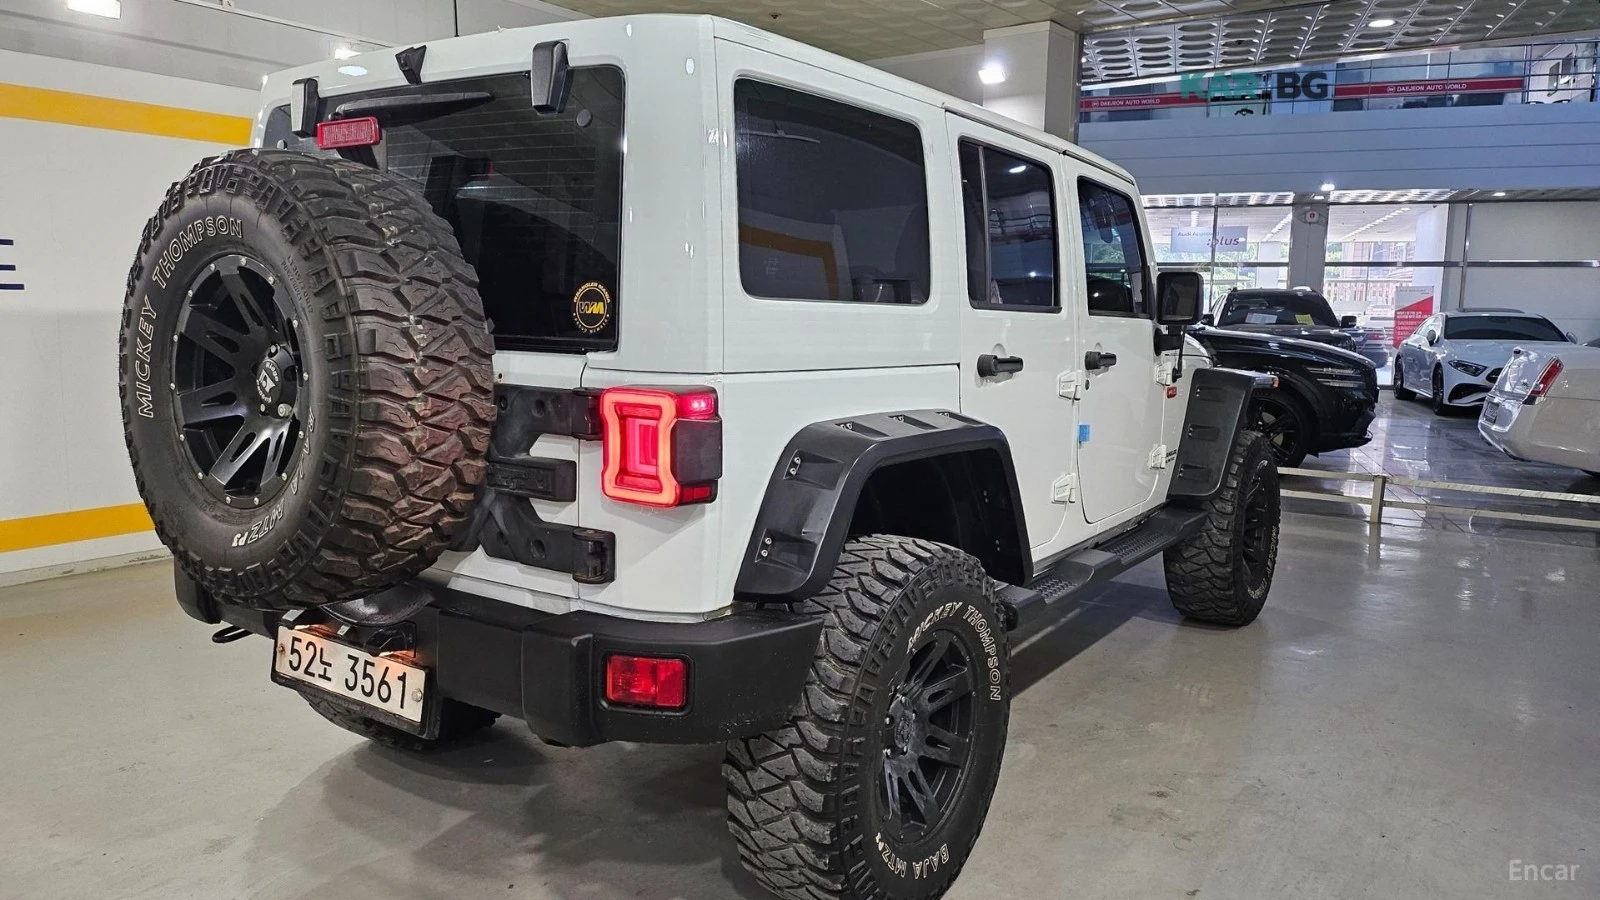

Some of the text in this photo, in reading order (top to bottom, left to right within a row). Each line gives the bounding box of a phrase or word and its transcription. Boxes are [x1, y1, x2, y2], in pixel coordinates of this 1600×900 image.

[135, 214, 243, 419] MICKEY THOMPSON
[291, 406, 315, 495] BAJA
[288, 635, 408, 709] 52노 3561
[906, 601, 1001, 701] MICKEY THOMPSON
[911, 843, 949, 879] BAJA
